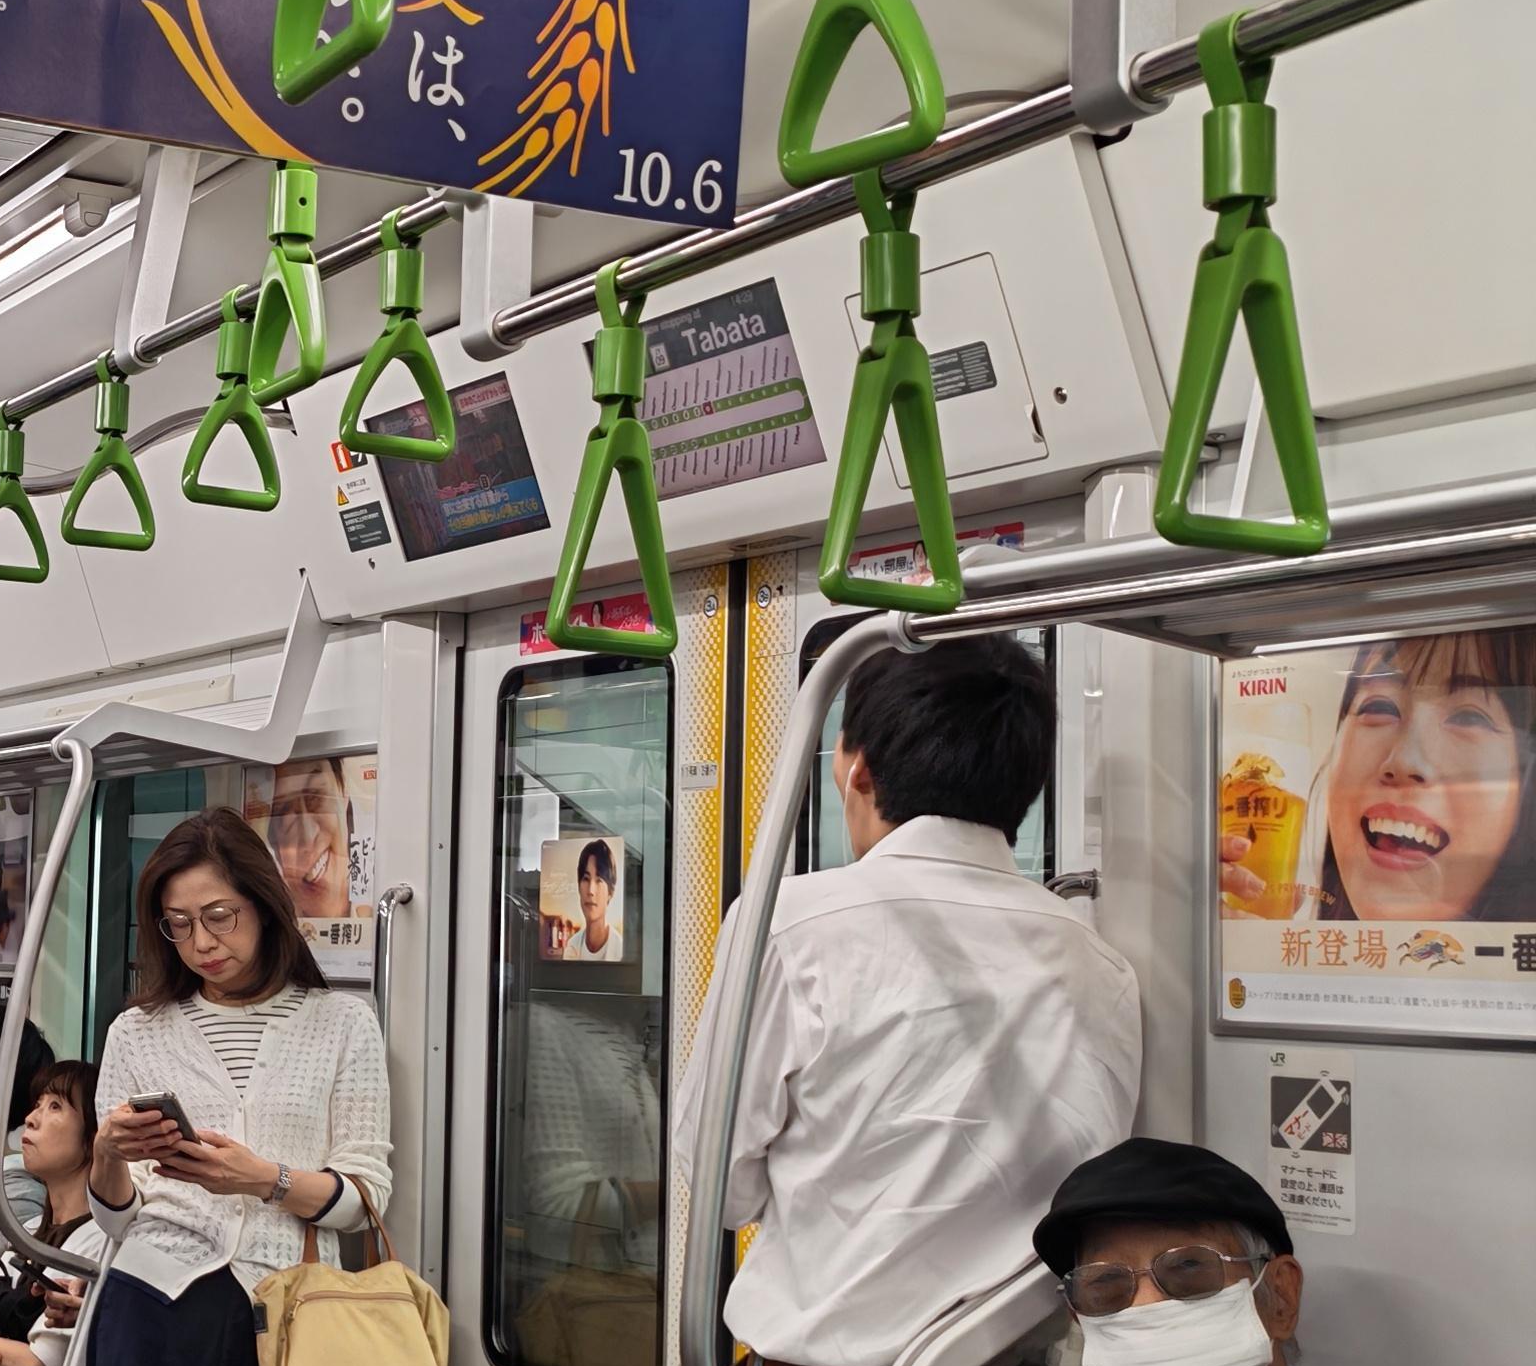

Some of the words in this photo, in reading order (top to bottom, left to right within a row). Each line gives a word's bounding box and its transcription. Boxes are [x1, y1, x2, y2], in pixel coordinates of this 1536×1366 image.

[613, 148, 723, 214] 10.6
[681, 313, 767, 356] Tabata
[1239, 677, 1287, 697] KIRIN
[1280, 927, 1388, 970] 新登場
[1270, 1052, 1286, 1064] JR
[1280, 1165, 1338, 1179] マナーモードに
